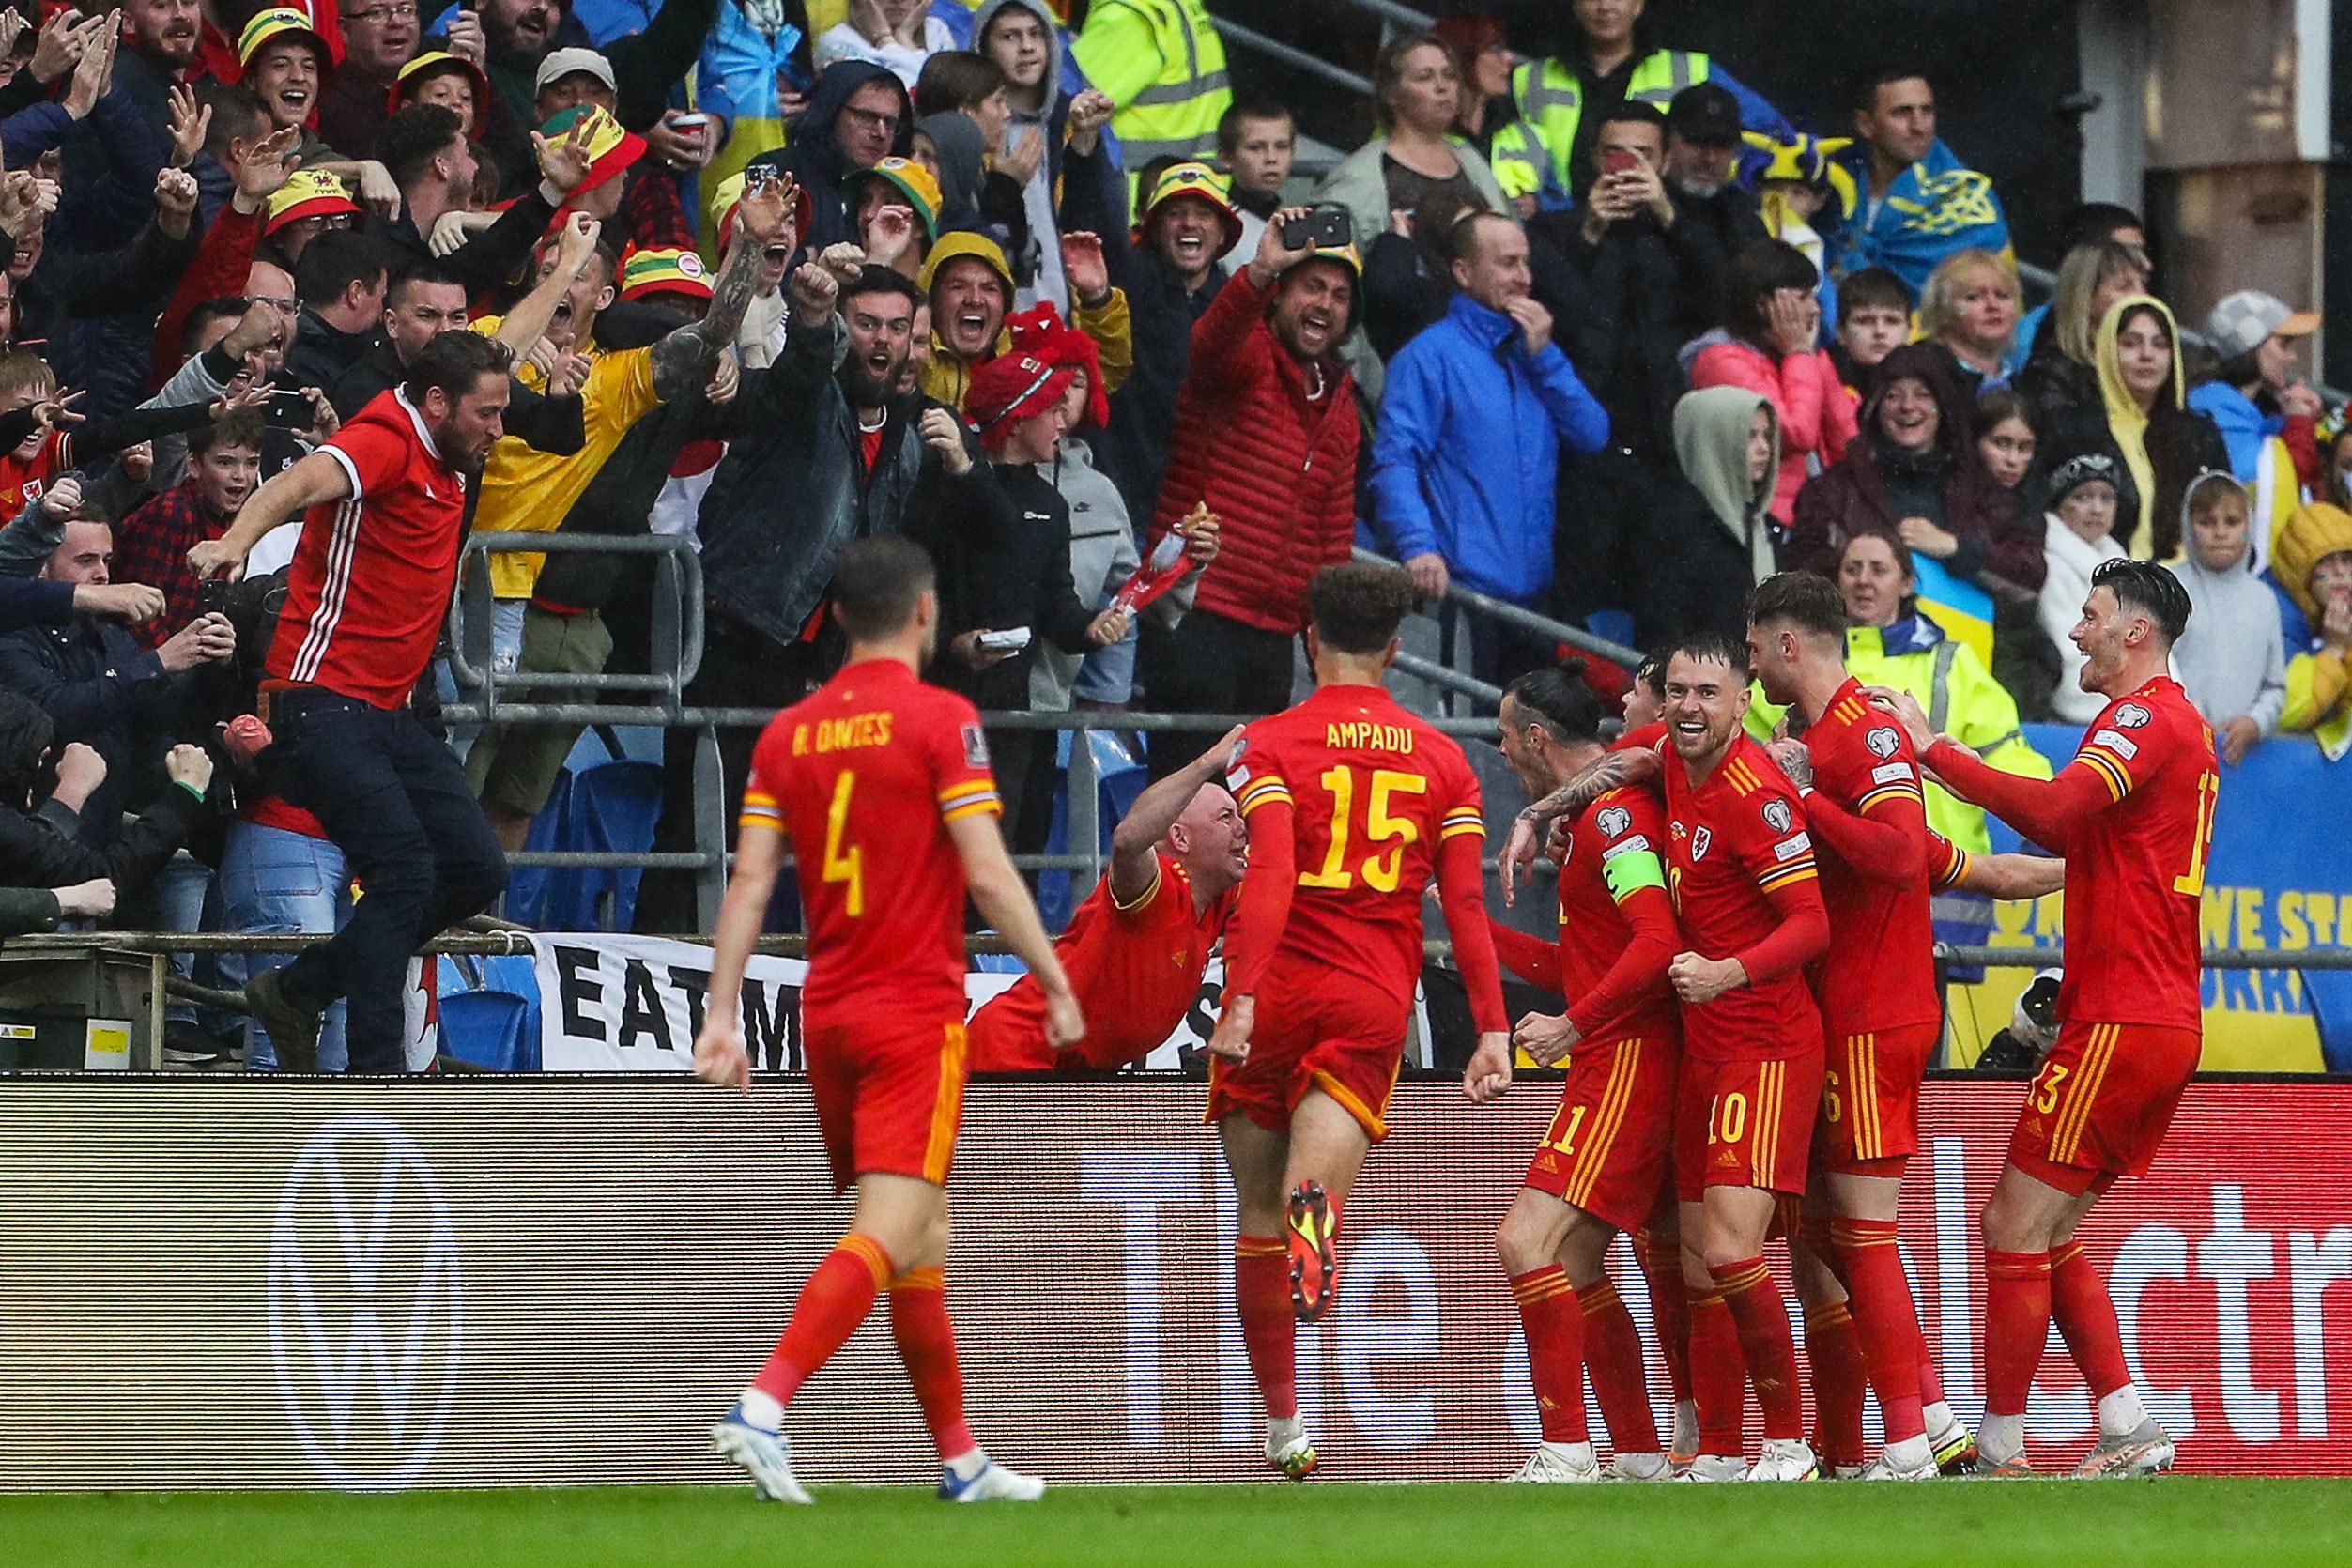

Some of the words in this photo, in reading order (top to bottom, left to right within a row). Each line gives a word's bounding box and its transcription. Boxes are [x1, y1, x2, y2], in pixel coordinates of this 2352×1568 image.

[1326, 722, 1412, 755] AMPADU
[822, 769, 864, 918] 4
[1297, 764, 1427, 893] 15
[1078, 1149, 1441, 1452] The
